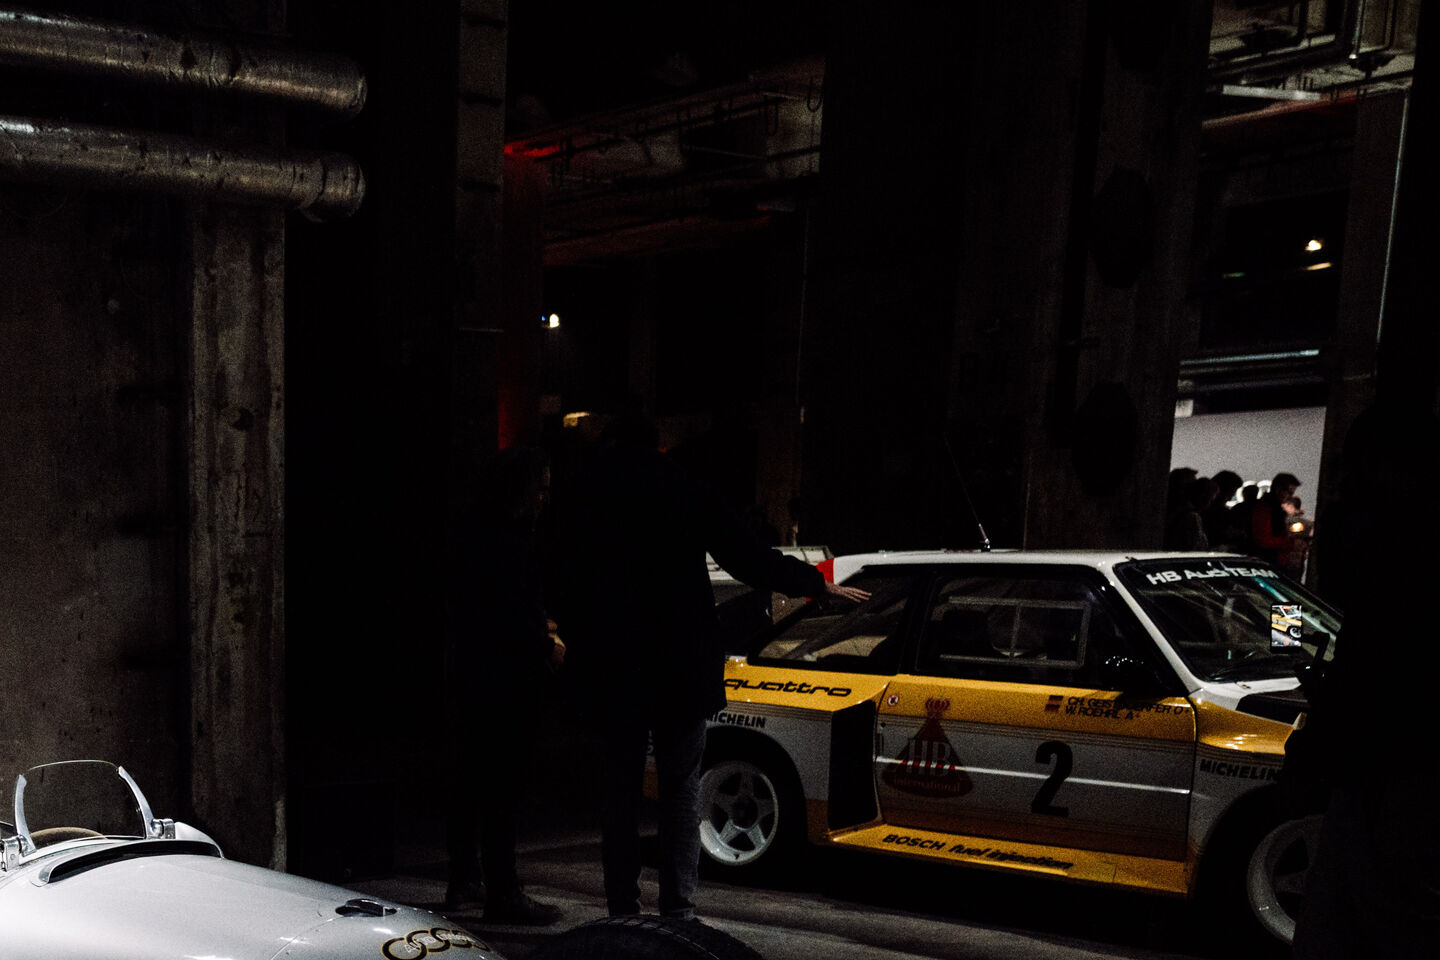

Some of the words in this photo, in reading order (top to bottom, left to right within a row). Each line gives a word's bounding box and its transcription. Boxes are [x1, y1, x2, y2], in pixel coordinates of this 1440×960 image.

[1145, 570, 1183, 585] HB
[1227, 567, 1280, 579] TEAM
[724, 677, 852, 698] quattro
[1031, 741, 1074, 818] 2
[1200, 758, 1282, 781] MICHELIN
[882, 833, 946, 851] BOSCH
